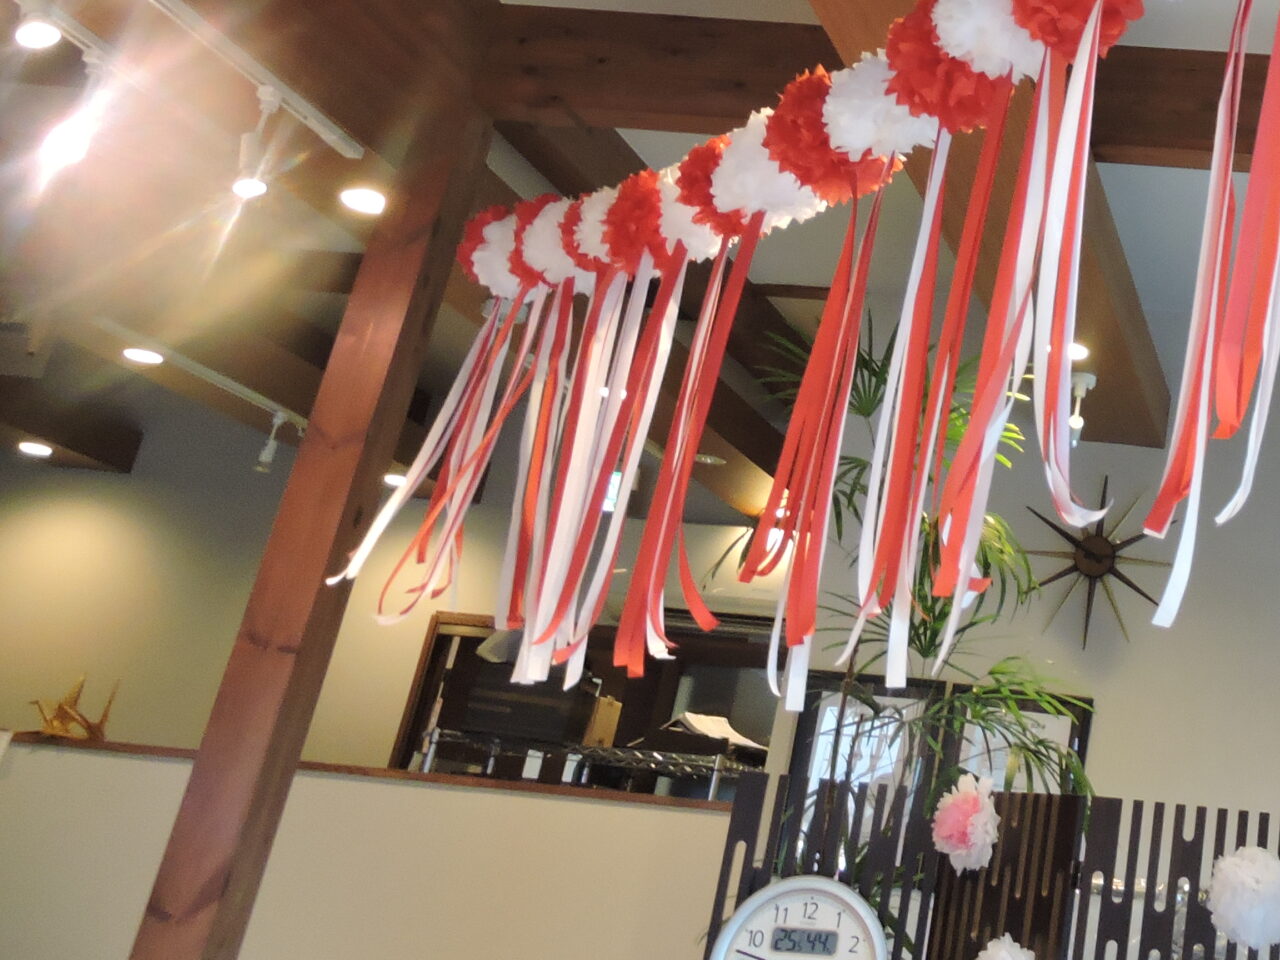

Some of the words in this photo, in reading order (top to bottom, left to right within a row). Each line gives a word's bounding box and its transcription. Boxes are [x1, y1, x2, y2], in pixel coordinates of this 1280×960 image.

[774, 903, 789, 925] 11
[803, 901, 819, 921] 12
[836, 911, 842, 929] 1
[748, 929, 765, 948] 10
[847, 935, 860, 954] 2
